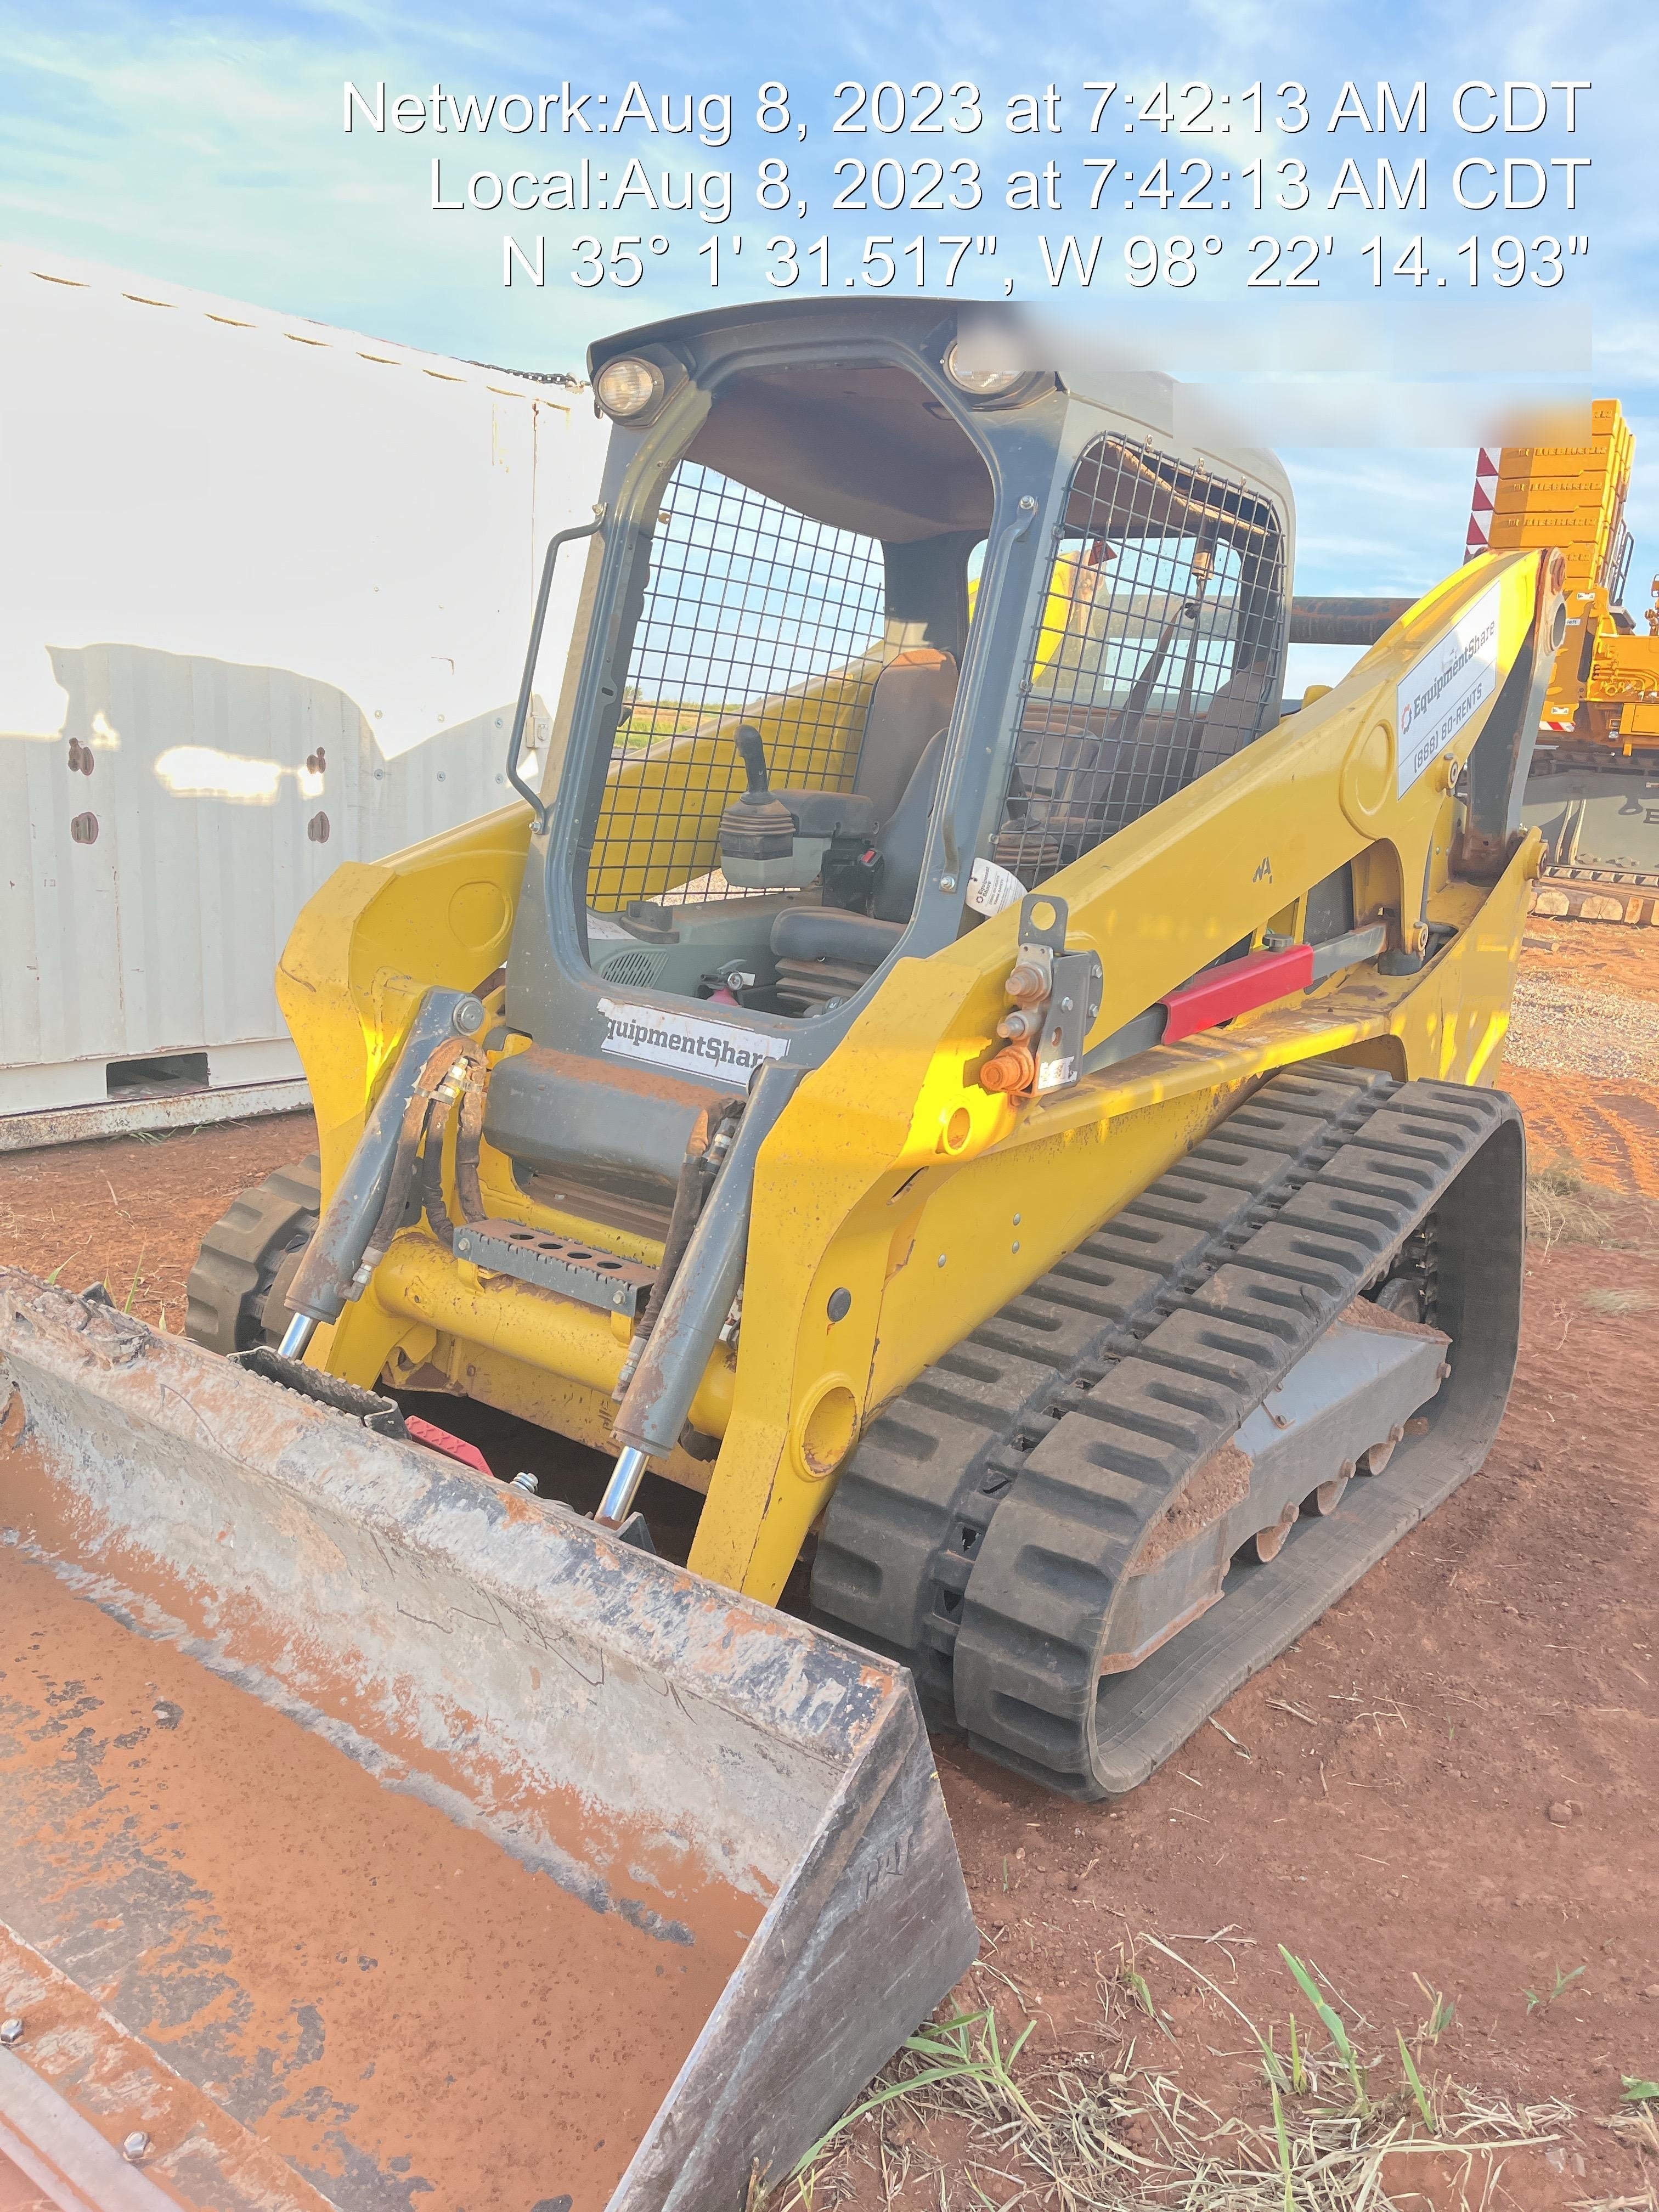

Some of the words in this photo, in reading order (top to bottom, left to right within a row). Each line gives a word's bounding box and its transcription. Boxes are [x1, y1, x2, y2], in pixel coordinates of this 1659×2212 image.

[1413, 620, 1496, 721] EquipmentShare
[1414, 731, 1438, 774] (888)
[1441, 683, 1483, 741] 80-RENTS
[607, 1019, 764, 1069] quipmentShar
